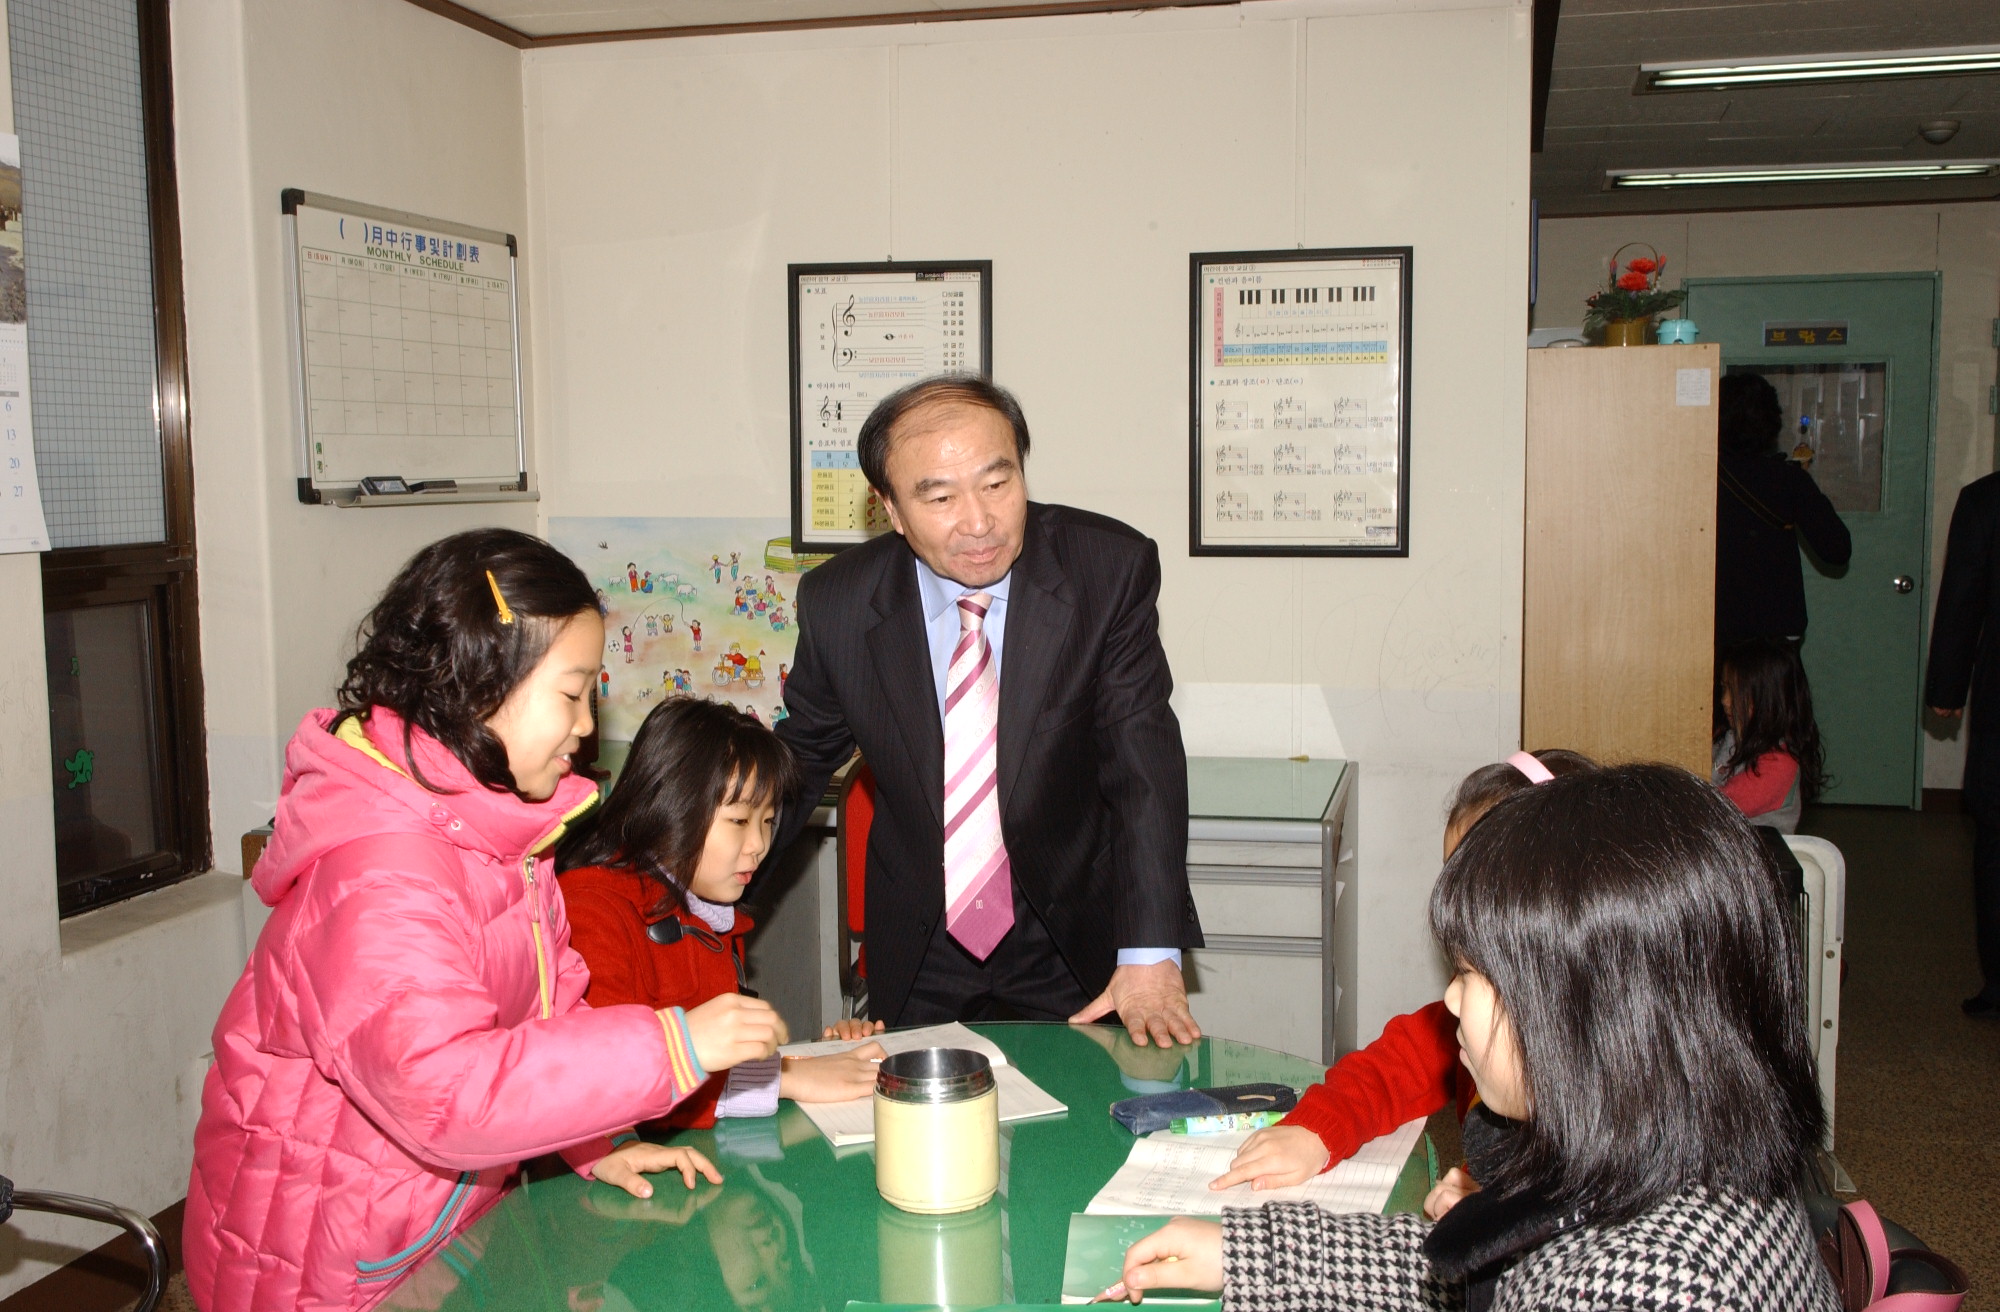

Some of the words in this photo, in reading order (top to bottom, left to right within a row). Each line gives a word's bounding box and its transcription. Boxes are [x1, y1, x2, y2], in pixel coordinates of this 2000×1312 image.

[366, 246, 412, 263] MONTHLY
[419, 255, 465, 272] SCHEDULE
[5, 400, 12, 412] 6
[7, 428, 16, 441] 13
[10, 457, 20, 469] 20
[14, 485, 23, 497] 27
